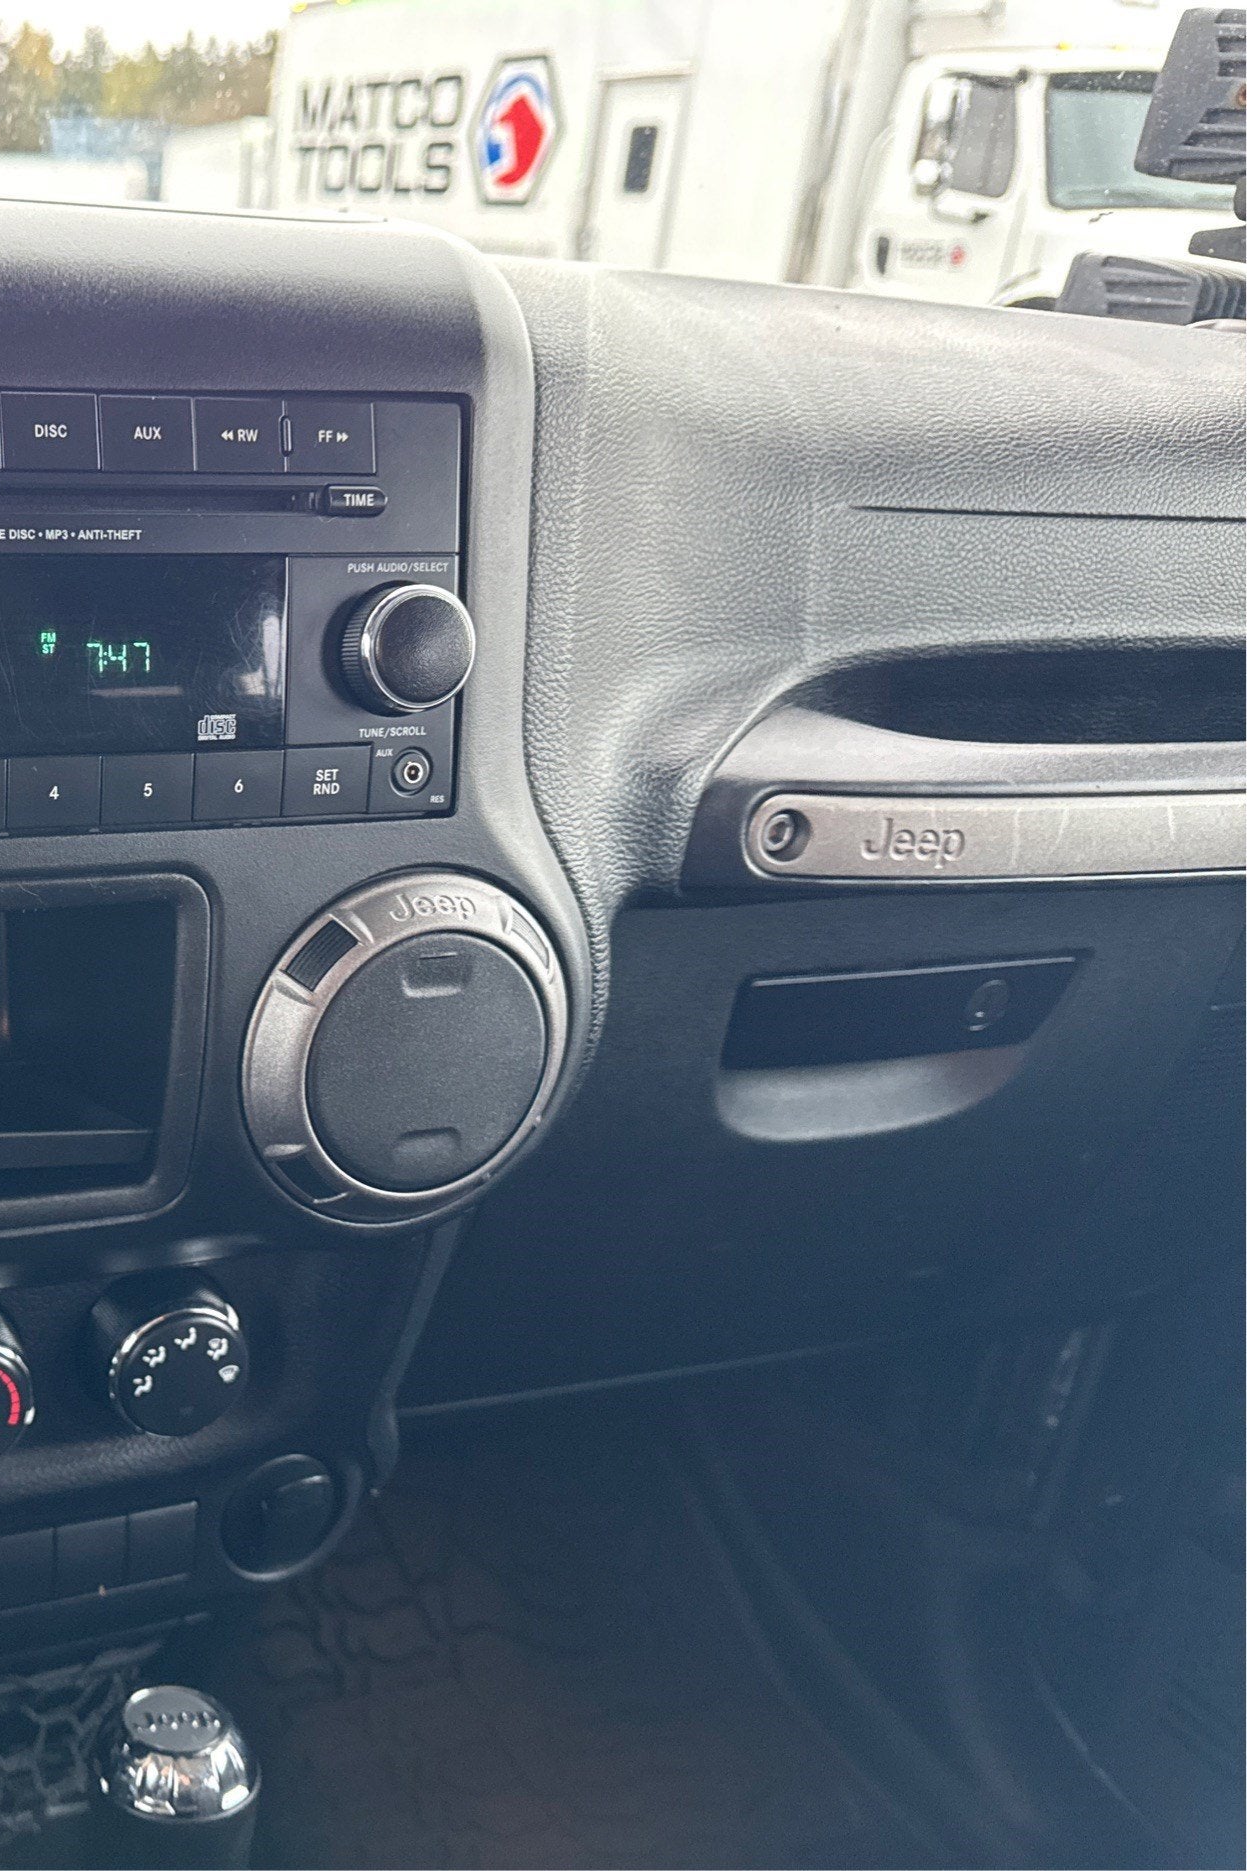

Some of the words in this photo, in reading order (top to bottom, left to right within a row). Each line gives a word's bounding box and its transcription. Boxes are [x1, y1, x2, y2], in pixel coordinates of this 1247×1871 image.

[296, 74, 464, 134] MATCO
[298, 141, 456, 197] TOOLS
[34, 424, 69, 439] DISC
[133, 426, 163, 441] AUX
[237, 428, 259, 443] RW
[318, 429, 333, 443] FF
[342, 493, 376, 508] TIME
[8, 528, 37, 541] DISC
[45, 529, 69, 541] MP3
[77, 529, 143, 542] ANTI-THEFT
[347, 562, 375, 575] PUSH
[376, 561, 450, 575] AUDIO/SELECT
[40, 632, 56, 643] FM
[41, 643, 55, 654] ST
[86, 642, 151, 673] 7:47
[358, 725, 428, 739] TUNE/SCROLL
[375, 748, 394, 758] AUX
[315, 768, 340, 782] SET
[49, 785, 60, 801] 4
[143, 782, 153, 798] 5
[234, 778, 245, 794] 6
[312, 782, 340, 796] RND
[429, 794, 445, 805] RES
[860, 817, 966, 870] Jeep
[389, 893, 477, 922] Jeep
